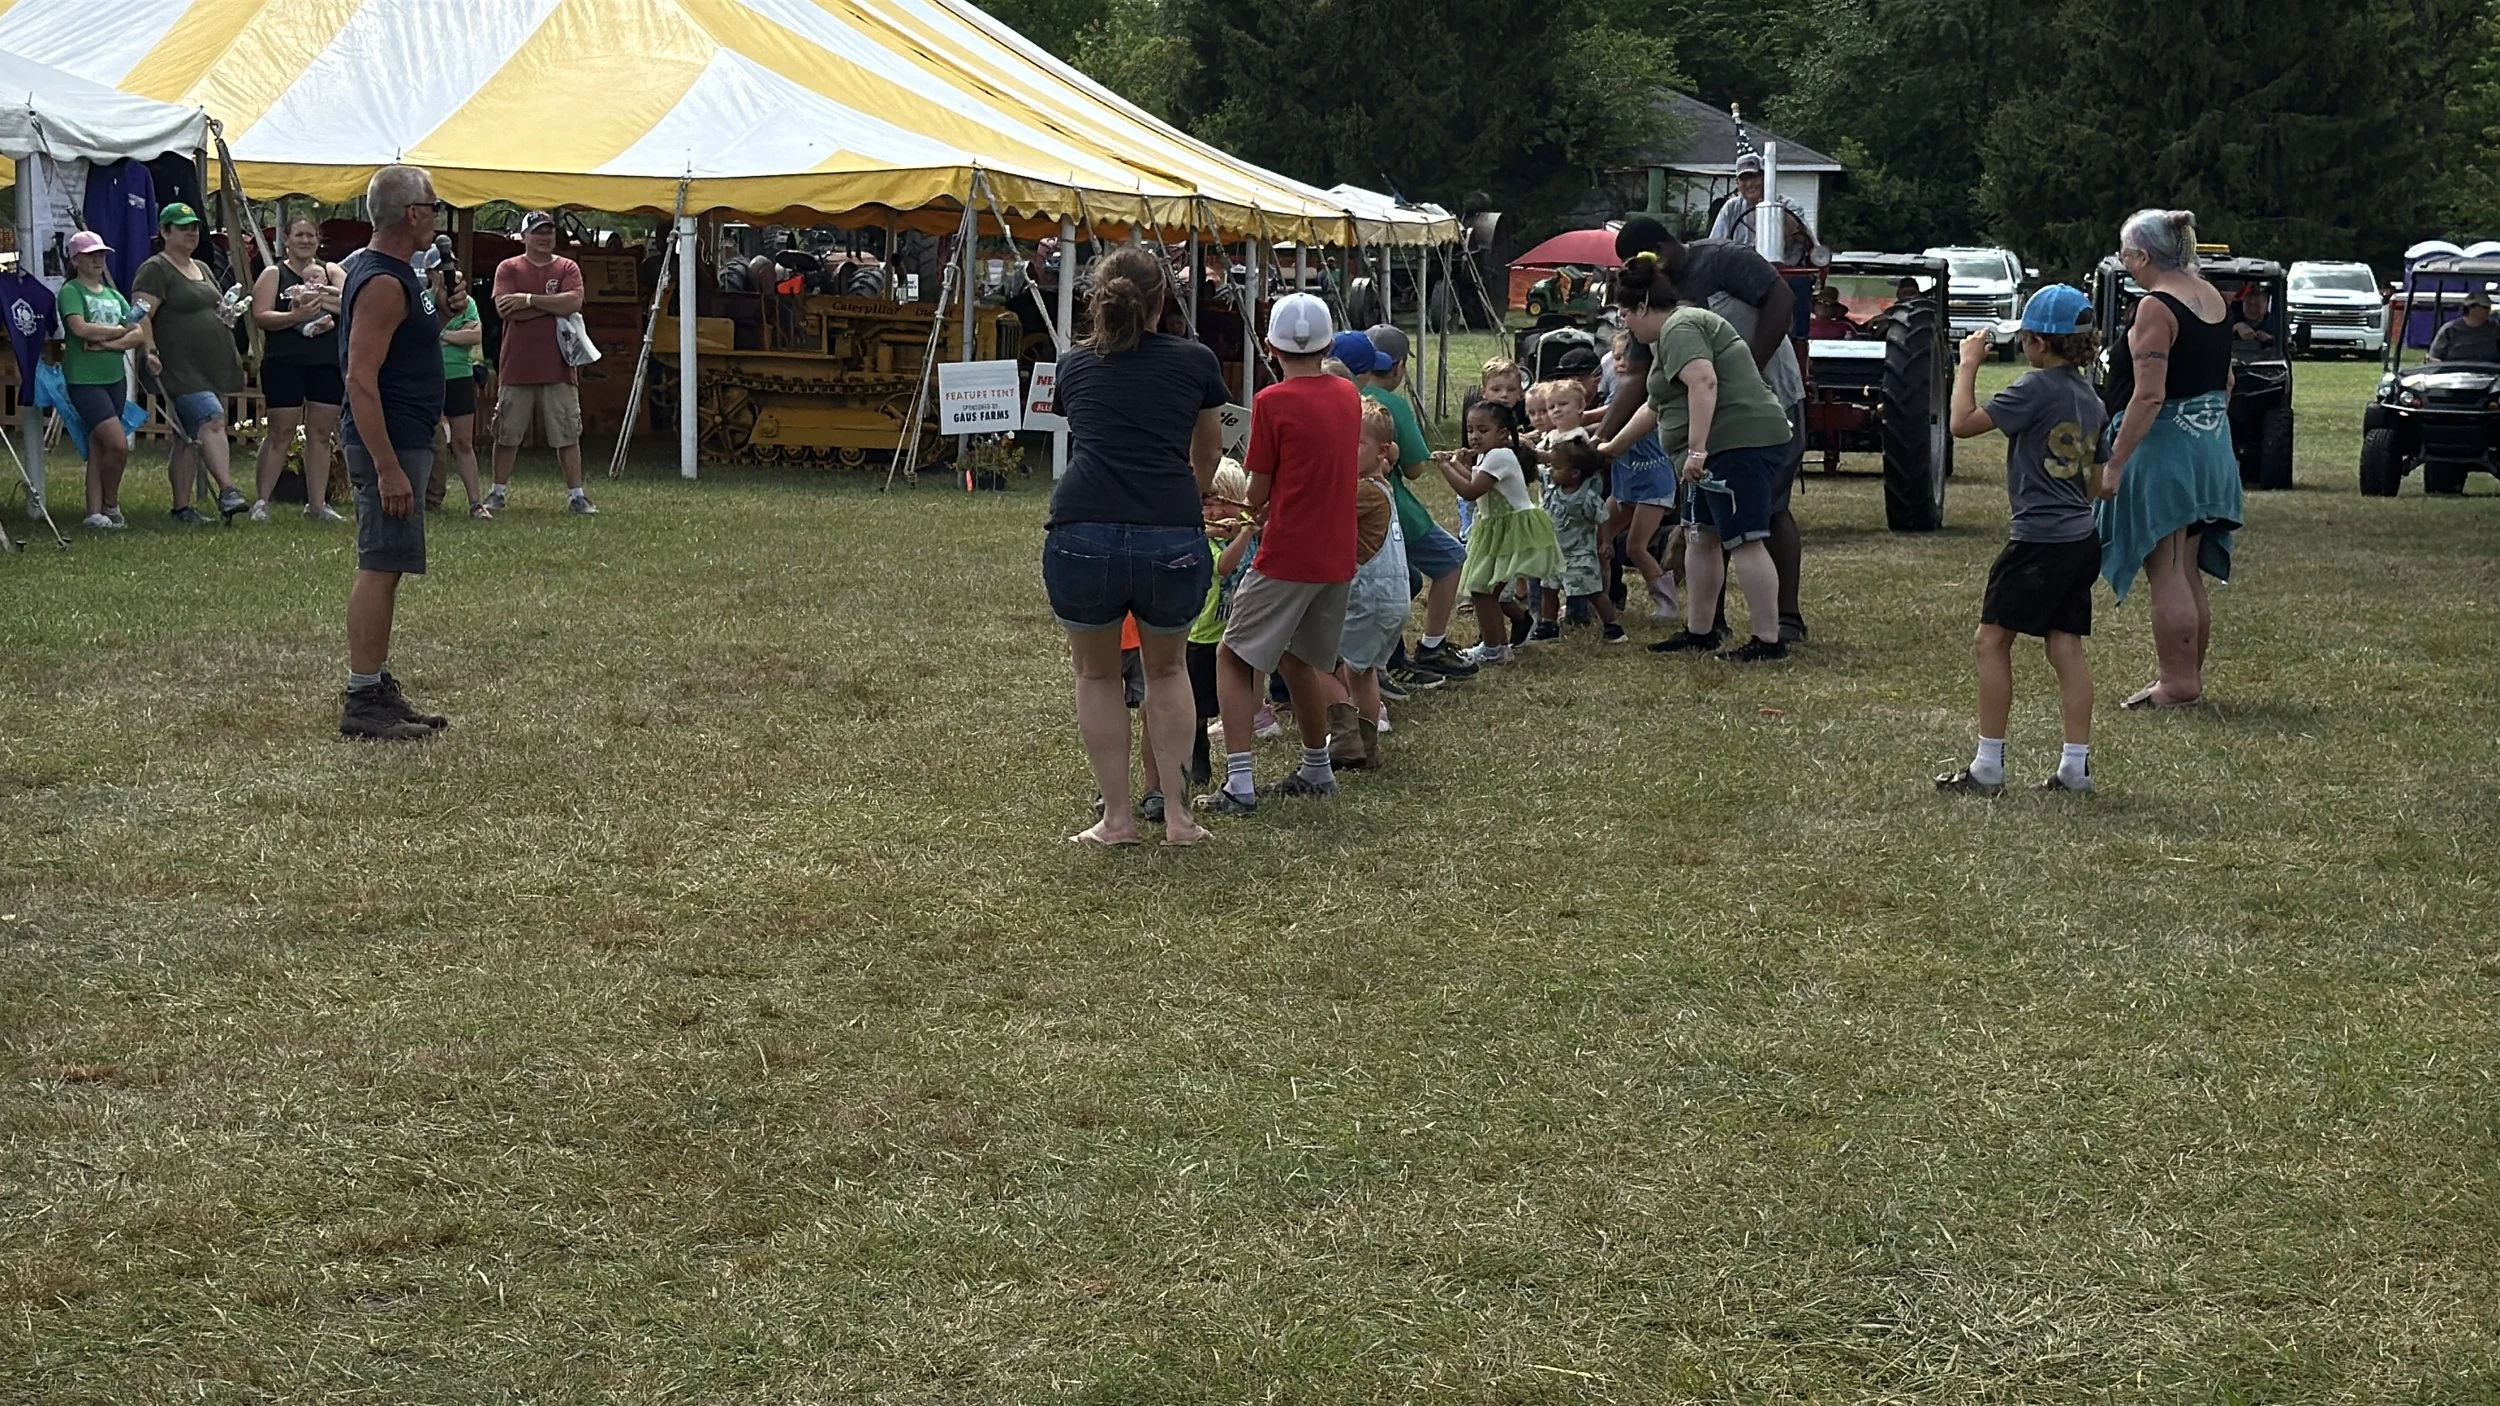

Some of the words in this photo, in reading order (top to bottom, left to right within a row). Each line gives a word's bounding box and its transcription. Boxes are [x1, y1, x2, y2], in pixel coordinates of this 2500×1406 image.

[832, 301, 901, 315] Caterpillar
[945, 391, 987, 401] FEATURE
[992, 388, 1015, 398] TENT
[953, 411, 977, 423] GAUS
[980, 410, 1009, 421] FARMS
